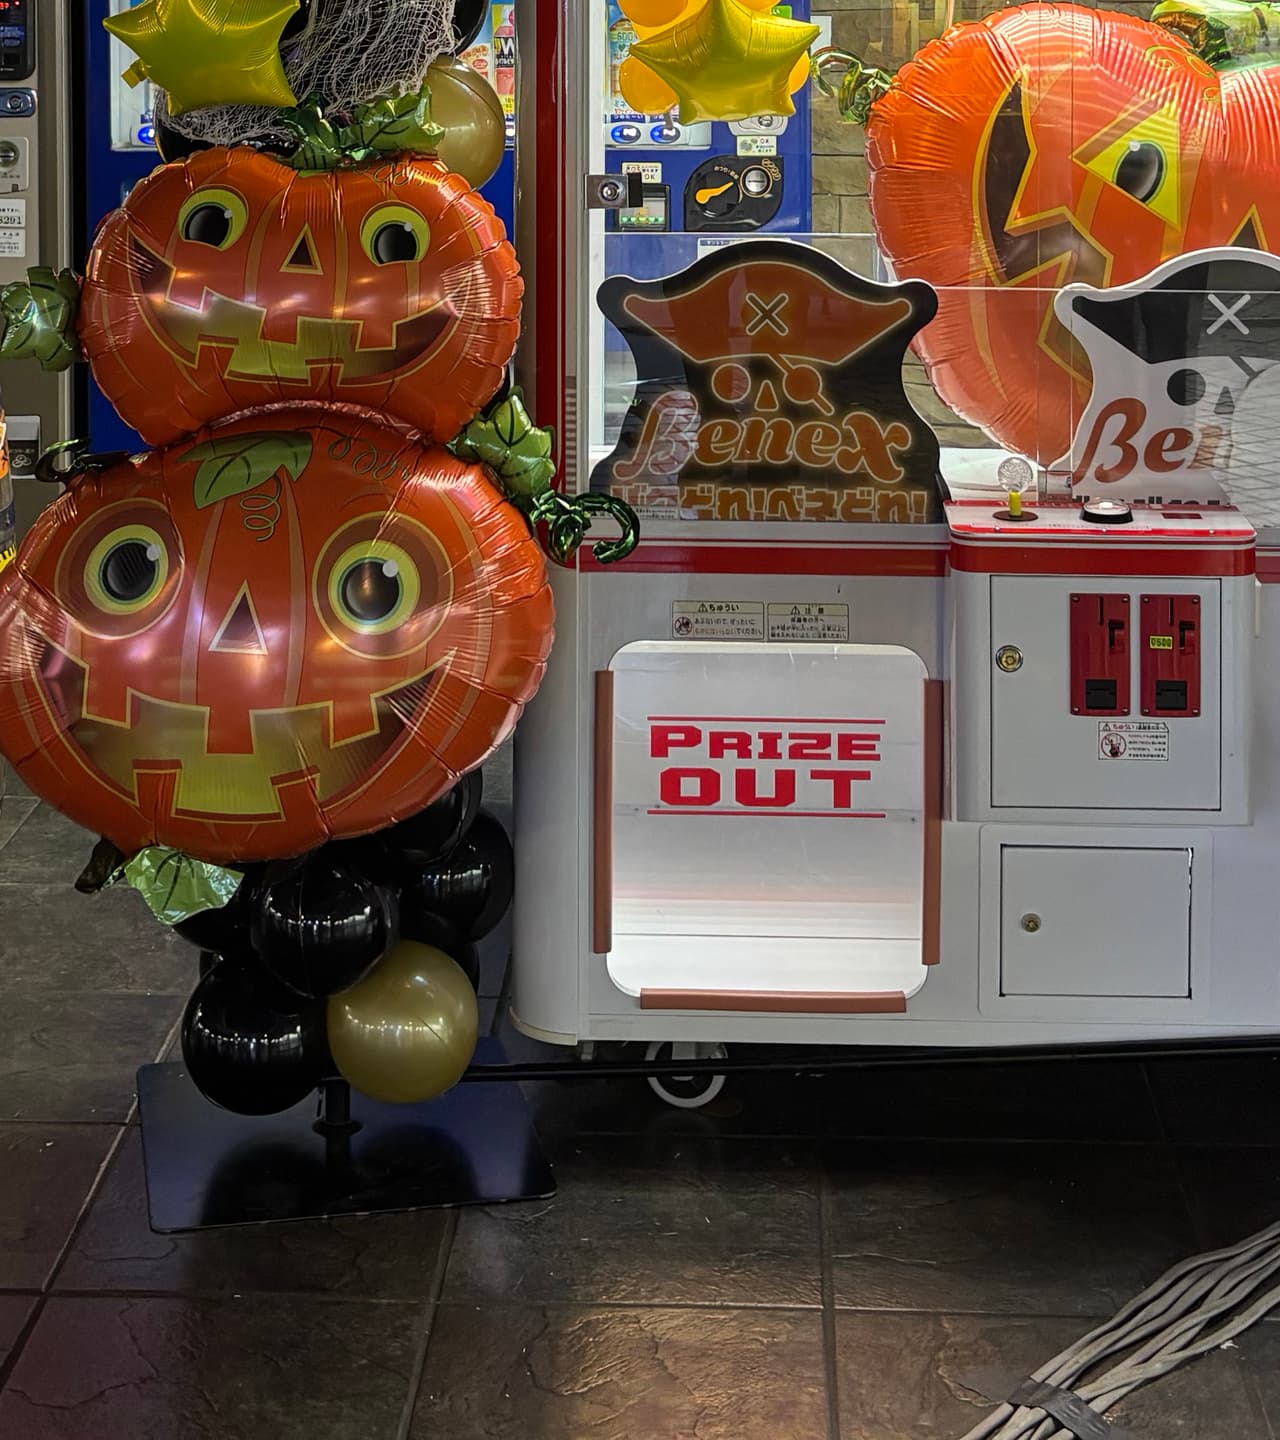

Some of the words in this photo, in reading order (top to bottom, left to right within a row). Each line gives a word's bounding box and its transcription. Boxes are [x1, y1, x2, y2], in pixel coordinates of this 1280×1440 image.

[613, 389, 913, 486] Benex
[649, 724, 882, 762] PRIZE
[658, 767, 872, 809] OUT
